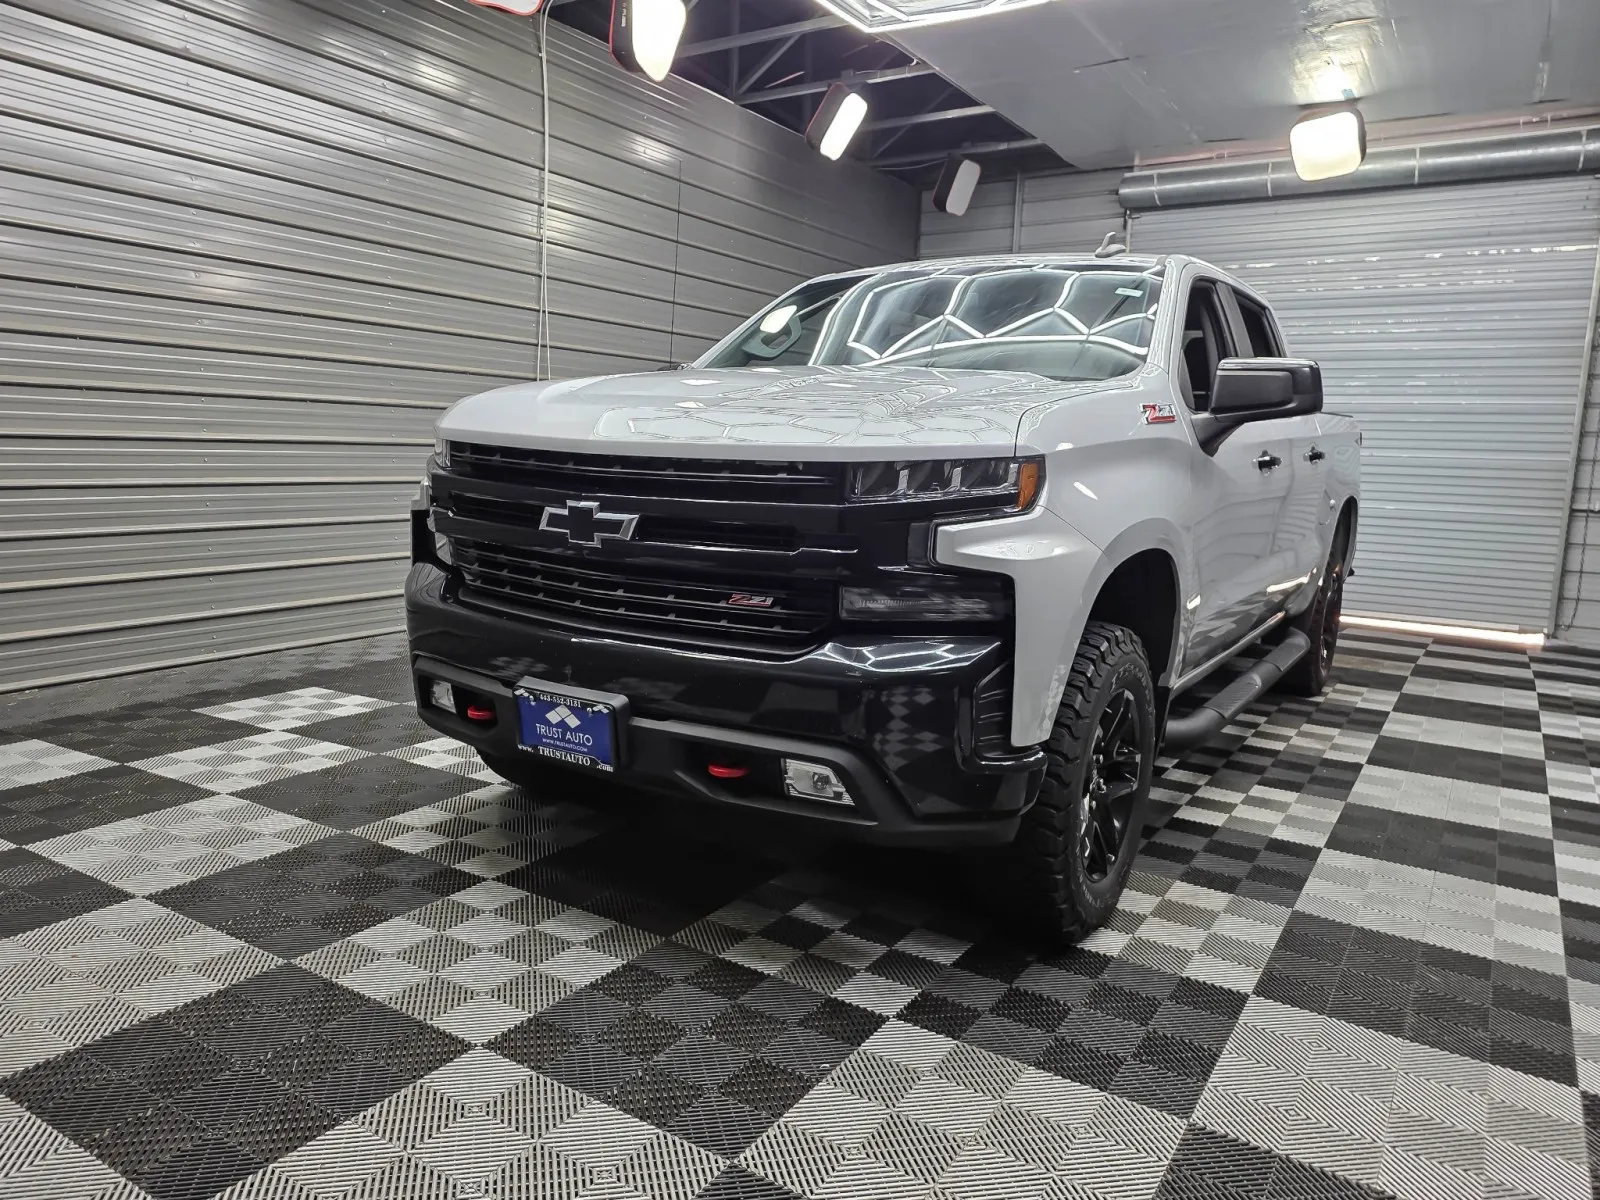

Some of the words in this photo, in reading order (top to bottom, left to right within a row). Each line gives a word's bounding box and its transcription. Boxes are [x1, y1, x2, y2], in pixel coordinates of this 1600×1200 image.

[535, 723, 563, 739] TRUST
[565, 731, 593, 746] AUTO
[537, 745, 591, 766] TRUSTAUTO
